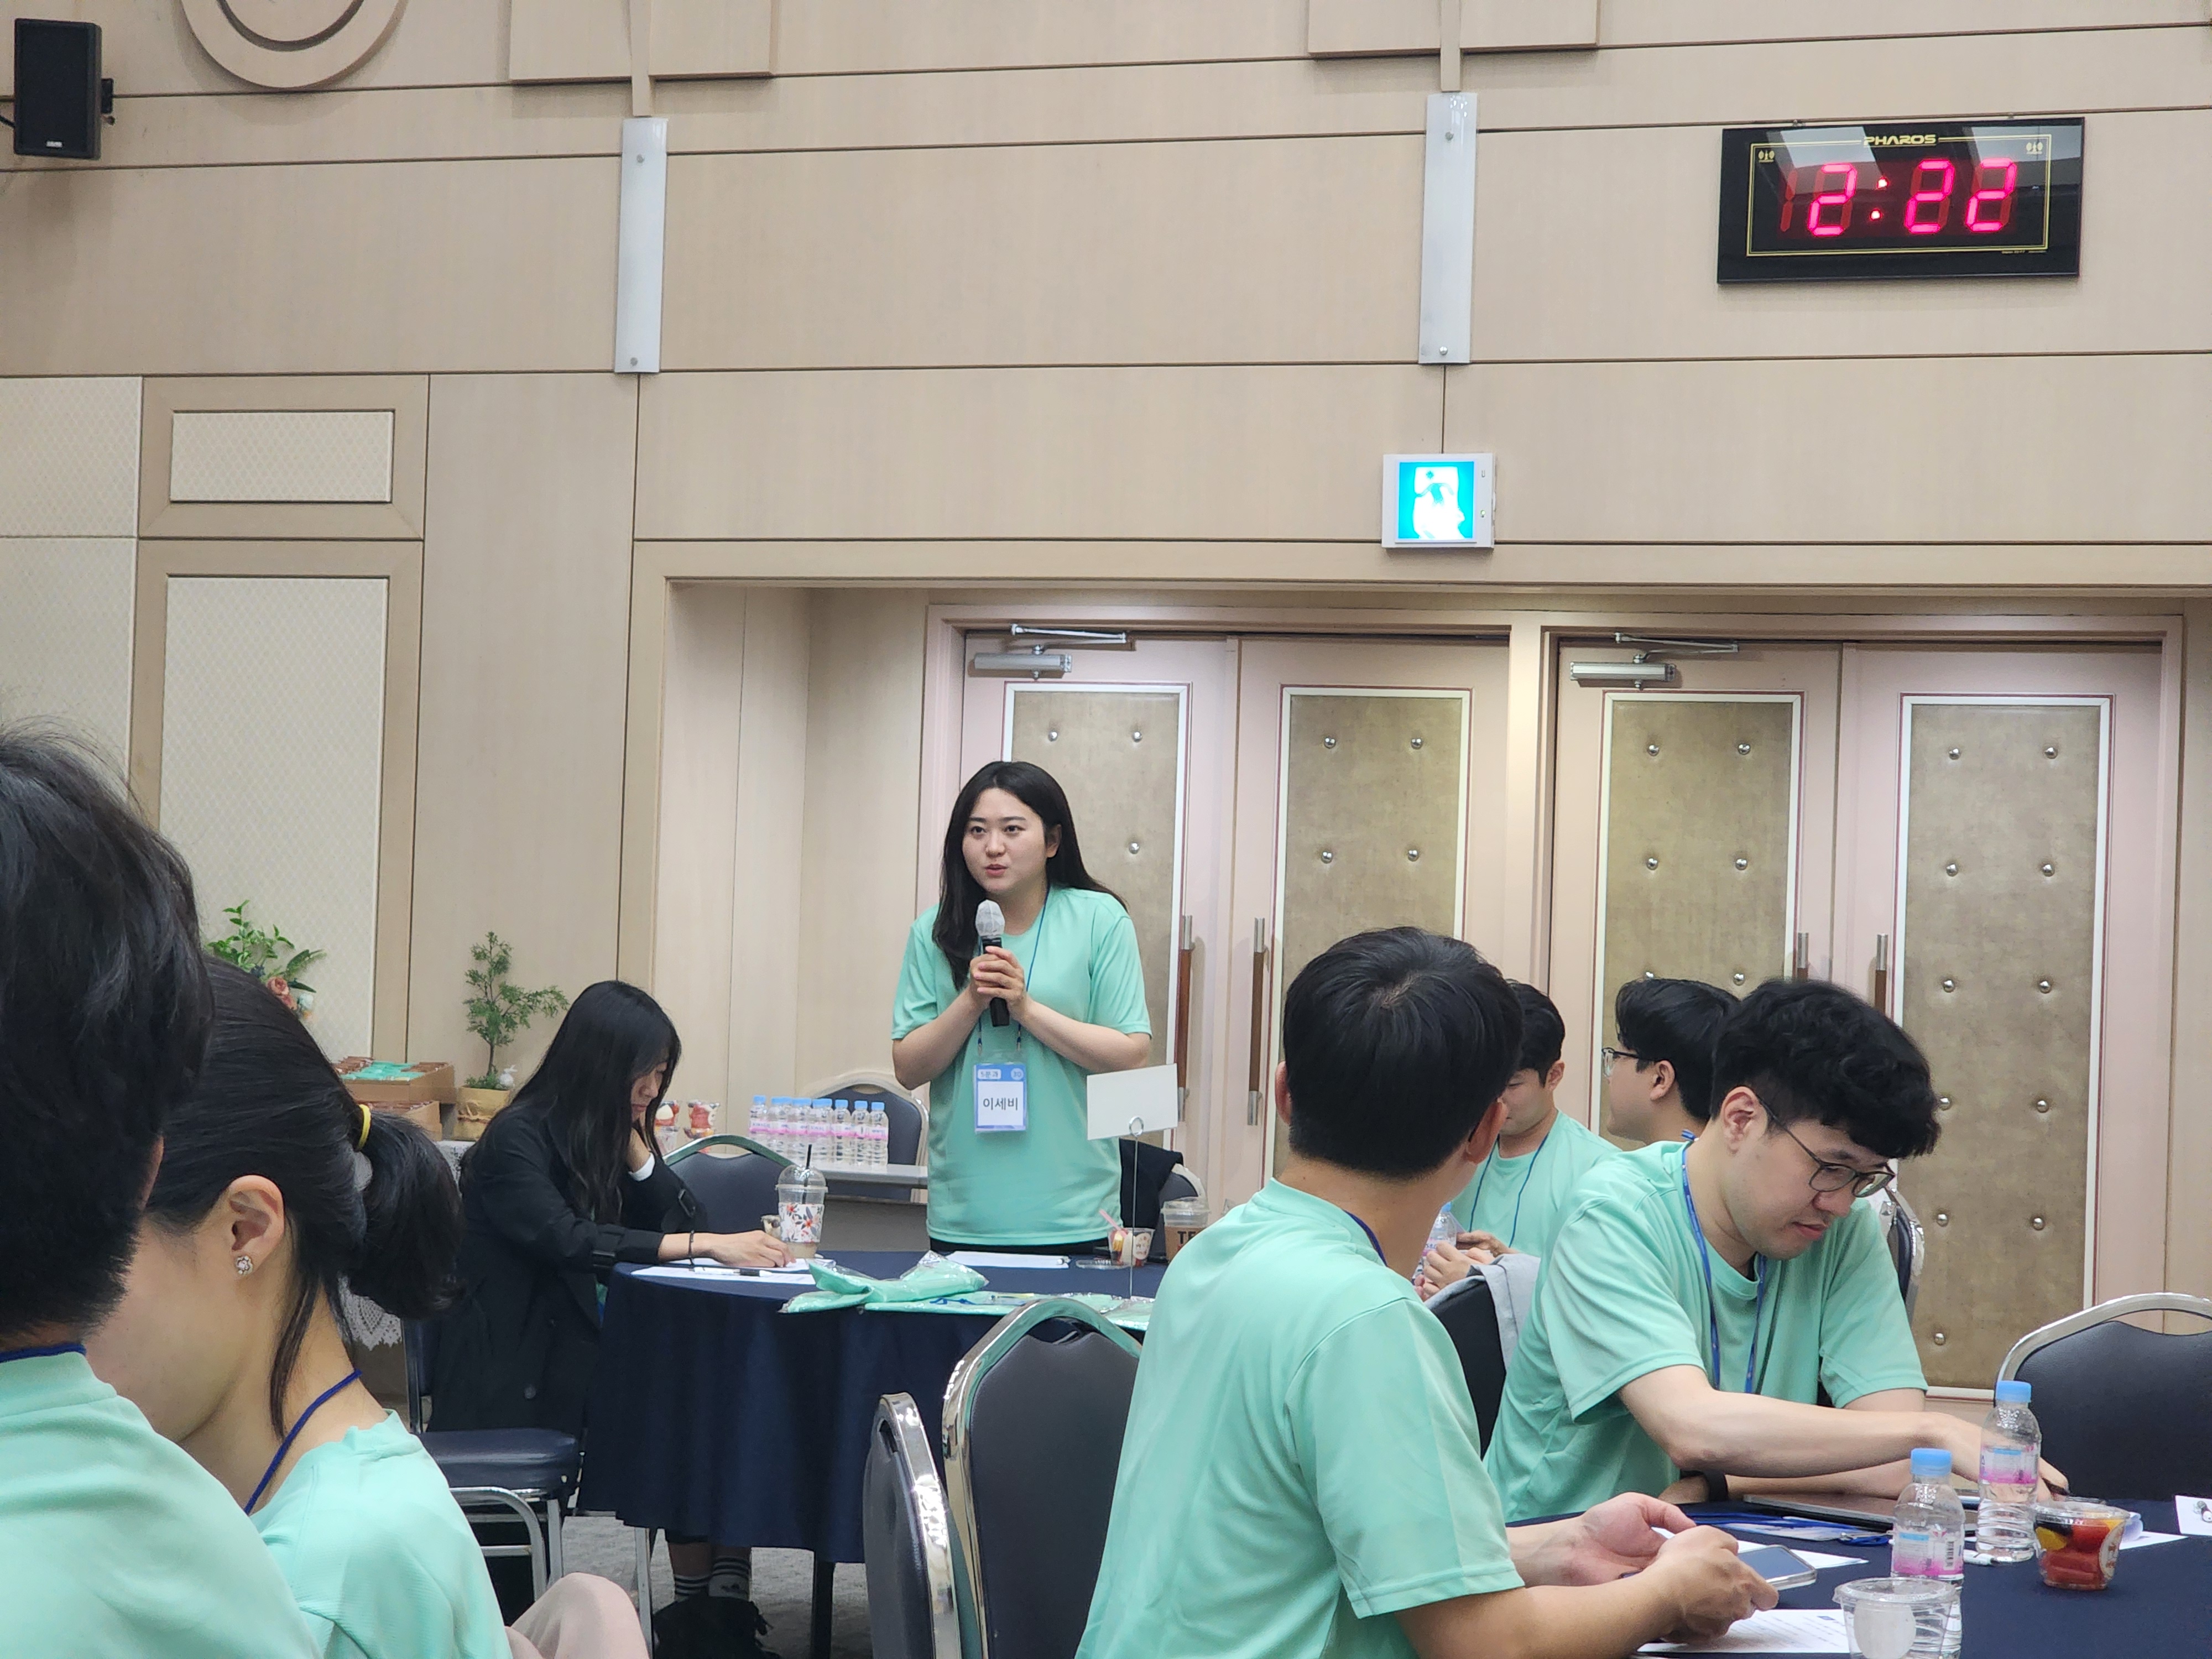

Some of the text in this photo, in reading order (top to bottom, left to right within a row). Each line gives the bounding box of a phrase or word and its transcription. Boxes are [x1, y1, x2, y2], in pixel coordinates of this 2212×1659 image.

[1864, 134, 1936, 146] PHAROS
[1807, 158, 2017, 237] 2:22
[983, 1097, 1018, 1110] 이세비
